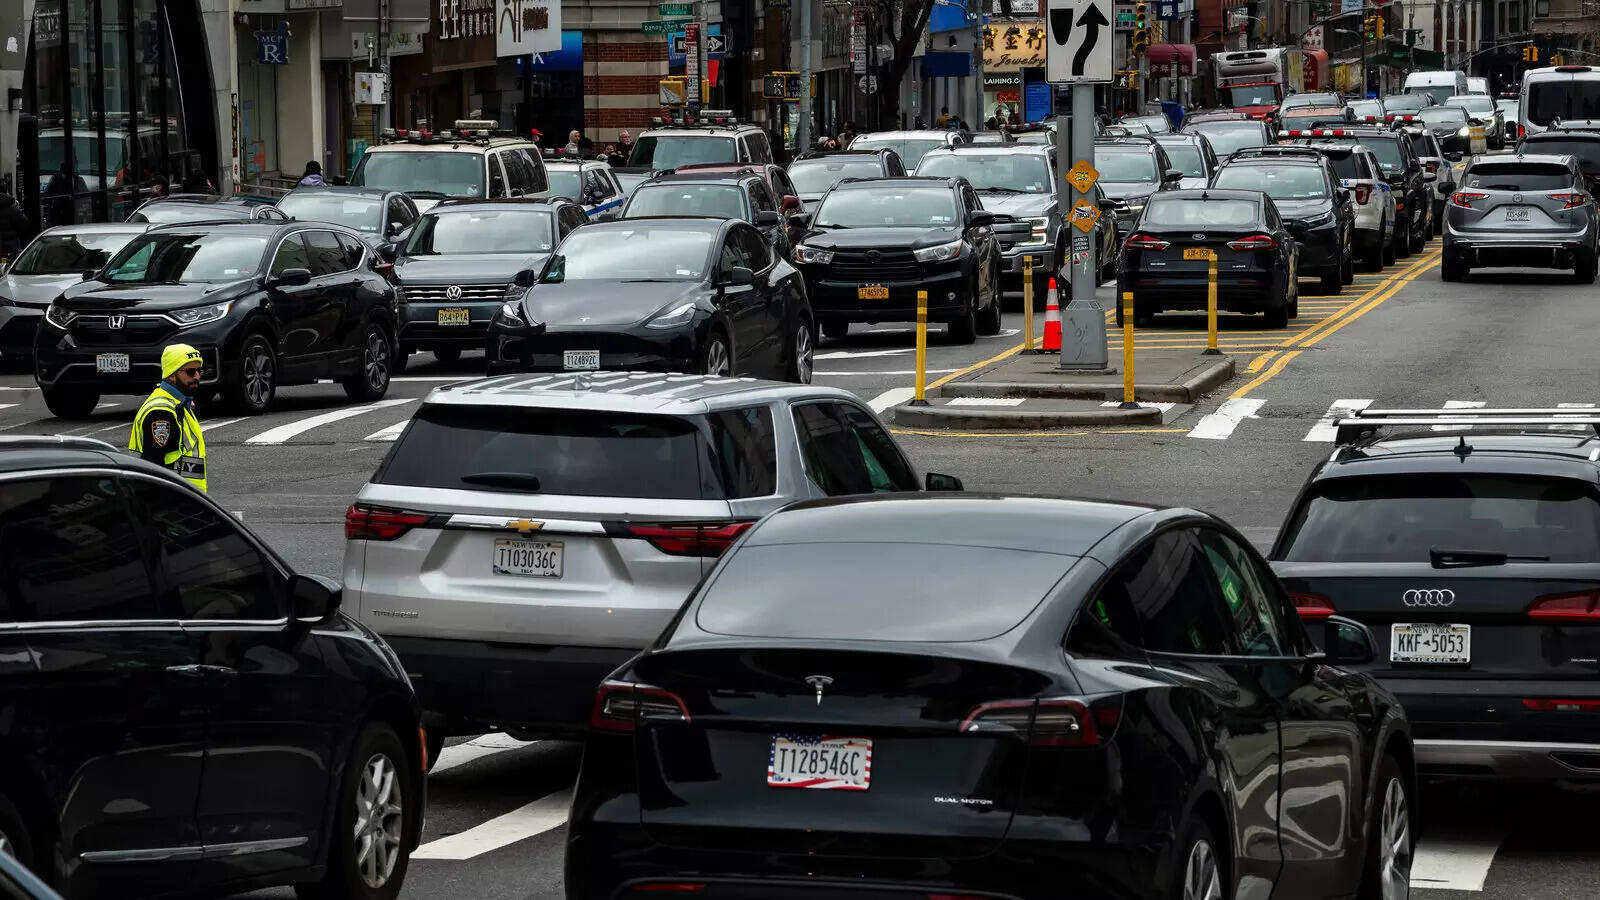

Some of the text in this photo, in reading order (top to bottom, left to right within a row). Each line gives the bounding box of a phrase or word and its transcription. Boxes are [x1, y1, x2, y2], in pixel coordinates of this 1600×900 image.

[499, 548, 557, 570] T103036C
[1413, 626, 1451, 635] NEW YORK
[780, 748, 860, 776] T128546C
